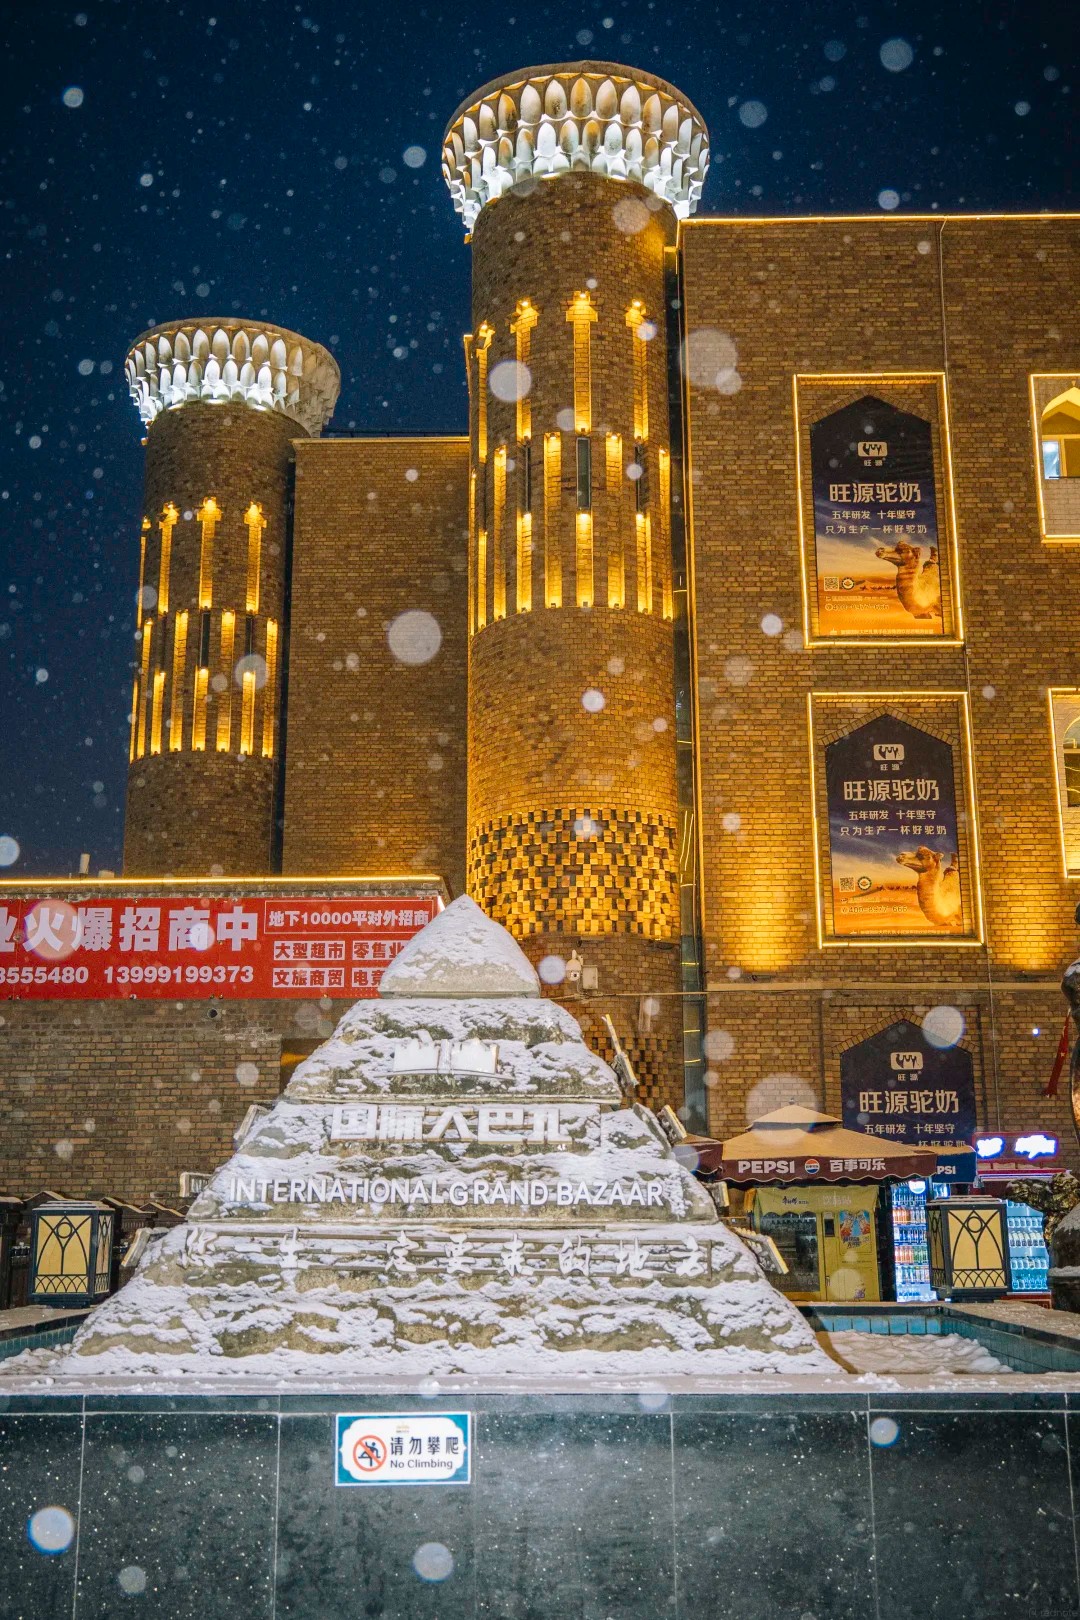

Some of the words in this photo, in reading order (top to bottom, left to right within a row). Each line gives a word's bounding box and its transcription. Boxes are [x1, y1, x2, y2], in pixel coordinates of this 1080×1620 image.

[829, 483, 922, 503] 旺源驼奶
[832, 510, 871, 520] 五年研发
[877, 510, 916, 520] 十年坚守
[825, 524, 928, 534] 只为生产一杯好驼奶
[843, 779, 940, 801] 旺源驼奶
[848, 810, 889, 820] 五年研发
[896, 810, 937, 820] 十年坚守
[840, 825, 947, 836] 只为生产一杯好驼奶
[269, 910, 429, 927] 地下10000平对外招商
[275, 942, 344, 959] 大型超市
[104, 965, 254, 983] 13999199373
[274, 969, 343, 986] 文旅商贸
[859, 1090, 959, 1114] 旺源驼奶
[330, 1104, 573, 1144] 国际大巴扎
[865, 1124, 906, 1134] 五年研发
[913, 1124, 955, 1134] 十年坚守
[738, 1161, 795, 1174] PEPSI
[830, 1158, 886, 1172] 百事可乐
[936, 1165, 957, 1175] PSI
[230, 1178, 445, 1204] INTERNATIONAL
[450, 1179, 549, 1206] GRAND
[557, 1179, 664, 1206] BAZAAR
[390, 1436, 459, 1455] 请勿攀爬
[390, 1460, 404, 1468] No
[408, 1459, 453, 1469] Climbing
